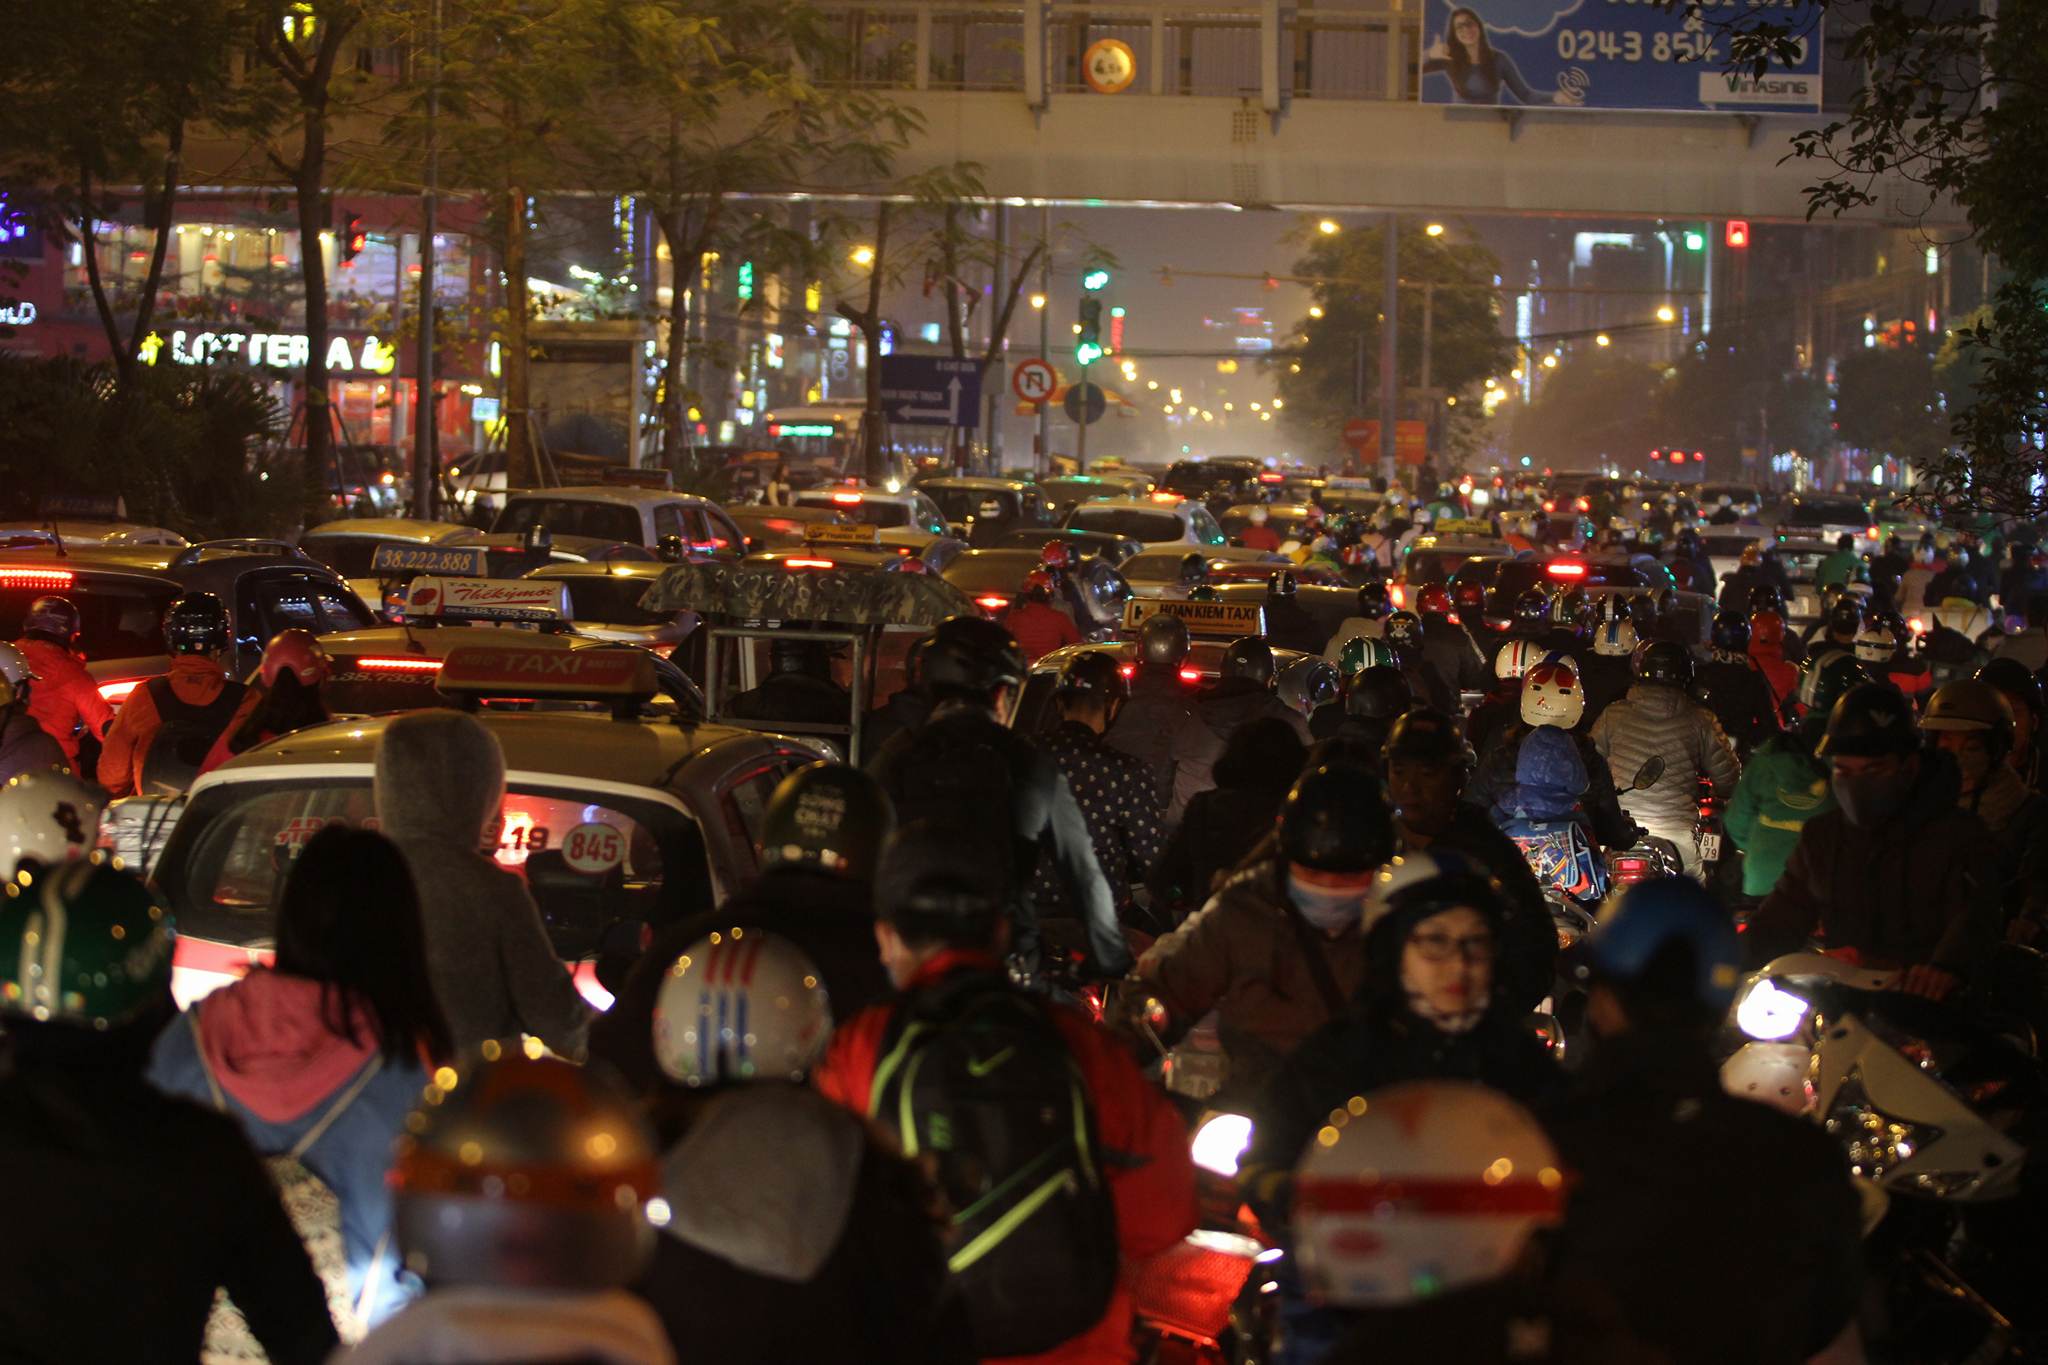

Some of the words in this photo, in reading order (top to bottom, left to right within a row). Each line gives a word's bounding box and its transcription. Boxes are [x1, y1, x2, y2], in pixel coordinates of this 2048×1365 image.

[1558, 29, 1642, 61] 0243
[1652, 32, 1720, 62] 854
[381, 549, 473, 571] 38.222.888
[1226, 606, 1256, 620] TAXI
[503, 653, 582, 675] TAXI
[570, 831, 618, 863] 845
